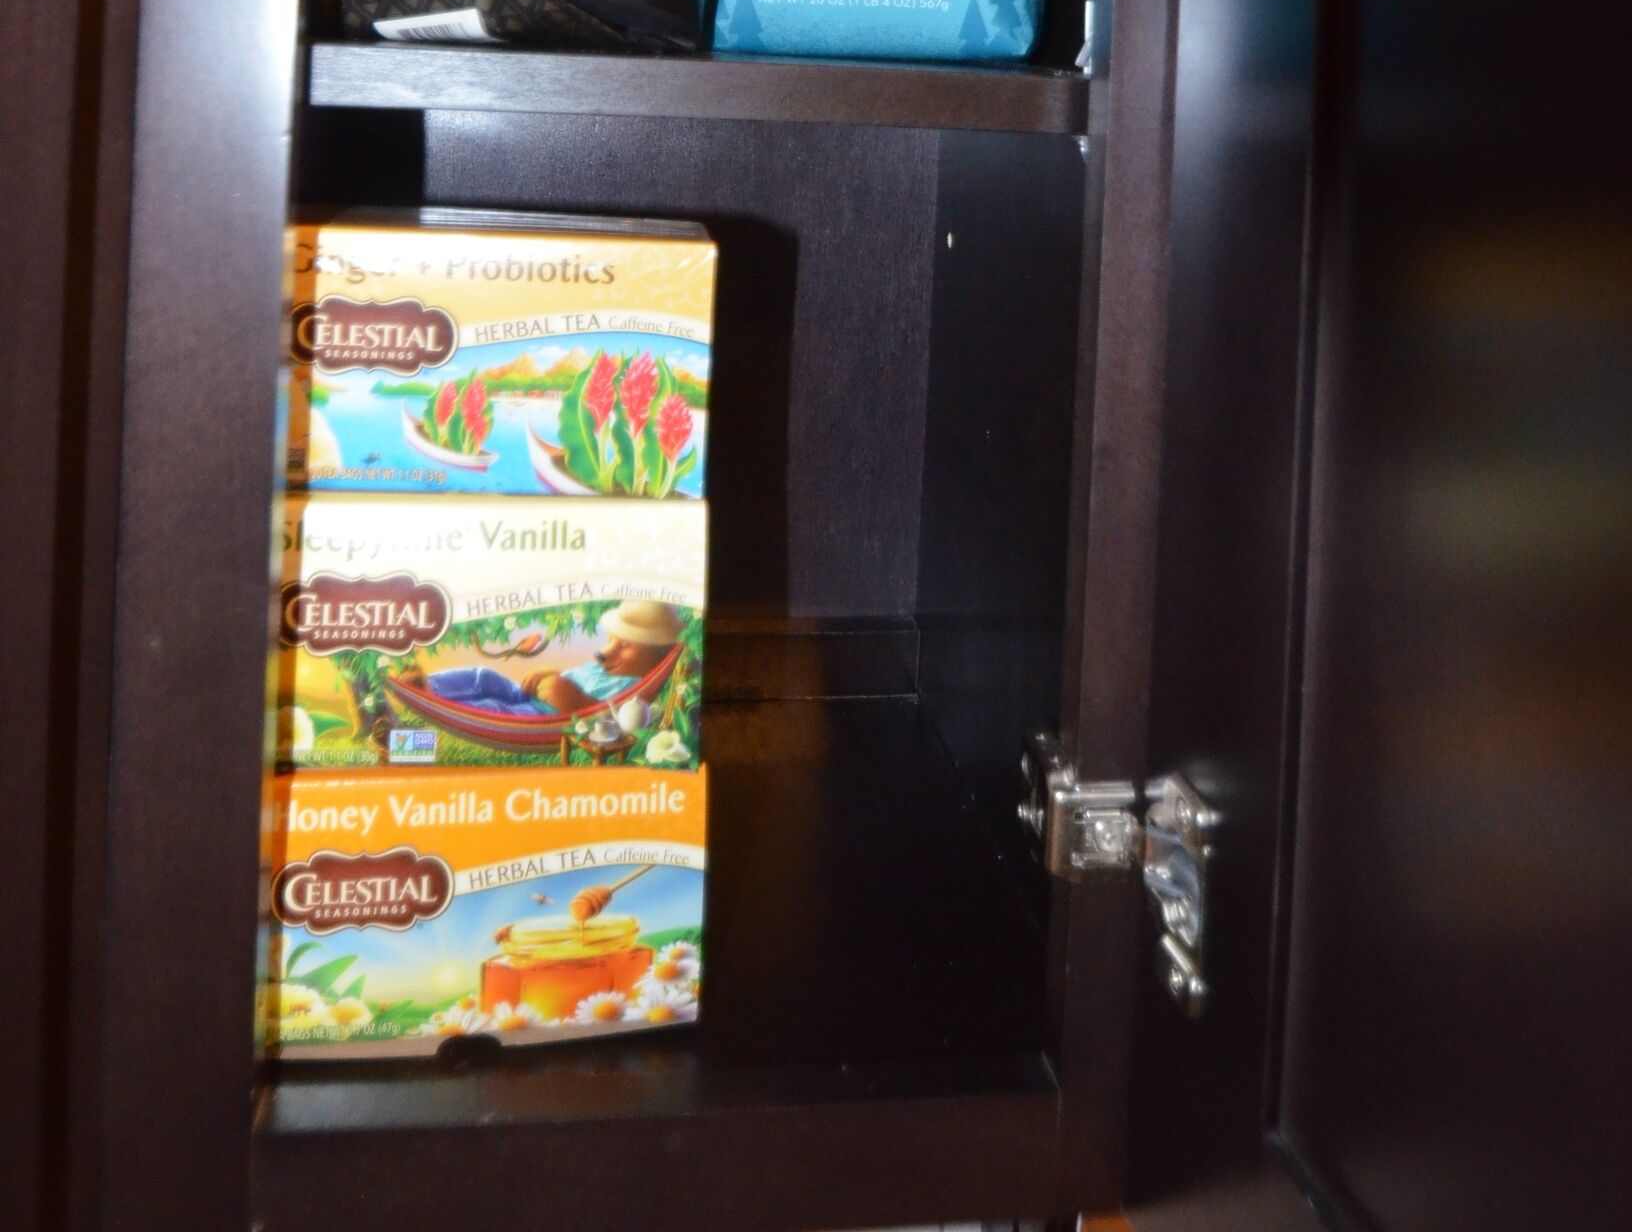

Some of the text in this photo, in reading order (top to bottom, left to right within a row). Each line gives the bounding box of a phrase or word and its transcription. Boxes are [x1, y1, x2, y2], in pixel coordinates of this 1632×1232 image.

[445, 253, 616, 285] Probiotics
[297, 313, 695, 352] CELESTIAL HERBAL TEA Caffeine Free
[324, 349, 415, 360] SEASONINGS
[479, 519, 587, 552] Vanilla
[285, 581, 688, 633] CELESTIAL HERBAL TEA Caffeine Free
[313, 628, 407, 640] SEASONINGS
[388, 791, 494, 828] Vanilla
[505, 781, 686, 821] Chamomile
[284, 847, 691, 912] CELESTIAL HERBAL TEA Caffeine Free
[314, 904, 408, 919] SEASONINGS
